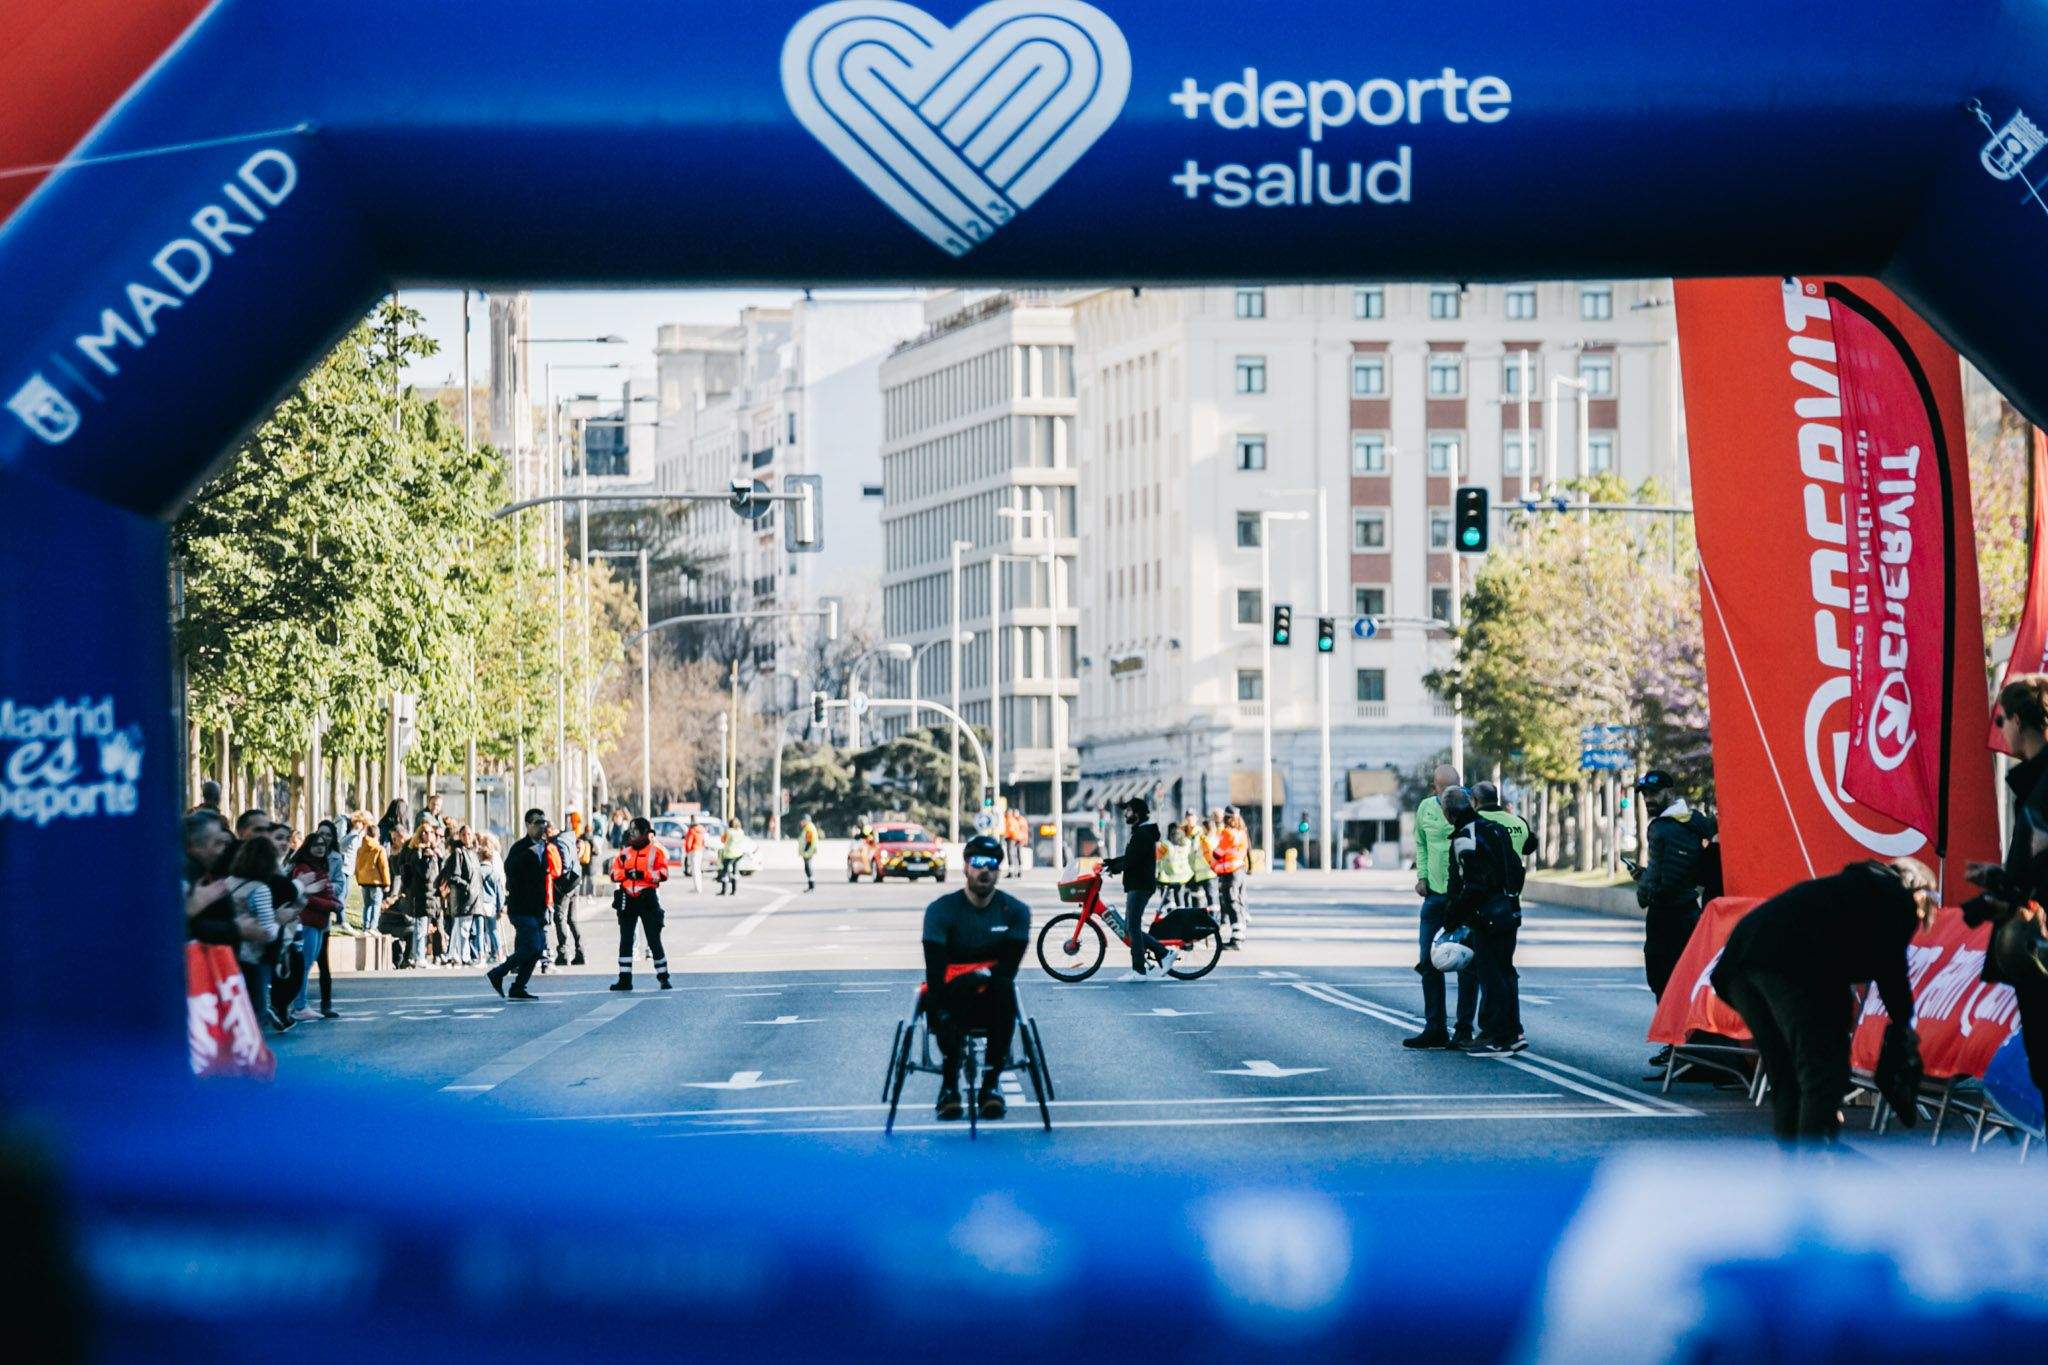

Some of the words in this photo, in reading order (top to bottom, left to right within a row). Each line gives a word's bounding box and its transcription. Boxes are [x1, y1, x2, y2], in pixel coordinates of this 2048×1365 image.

[1169, 67, 1512, 141] +deporte
[1172, 145, 1412, 207] +salud
[75, 148, 298, 376] MADRID
